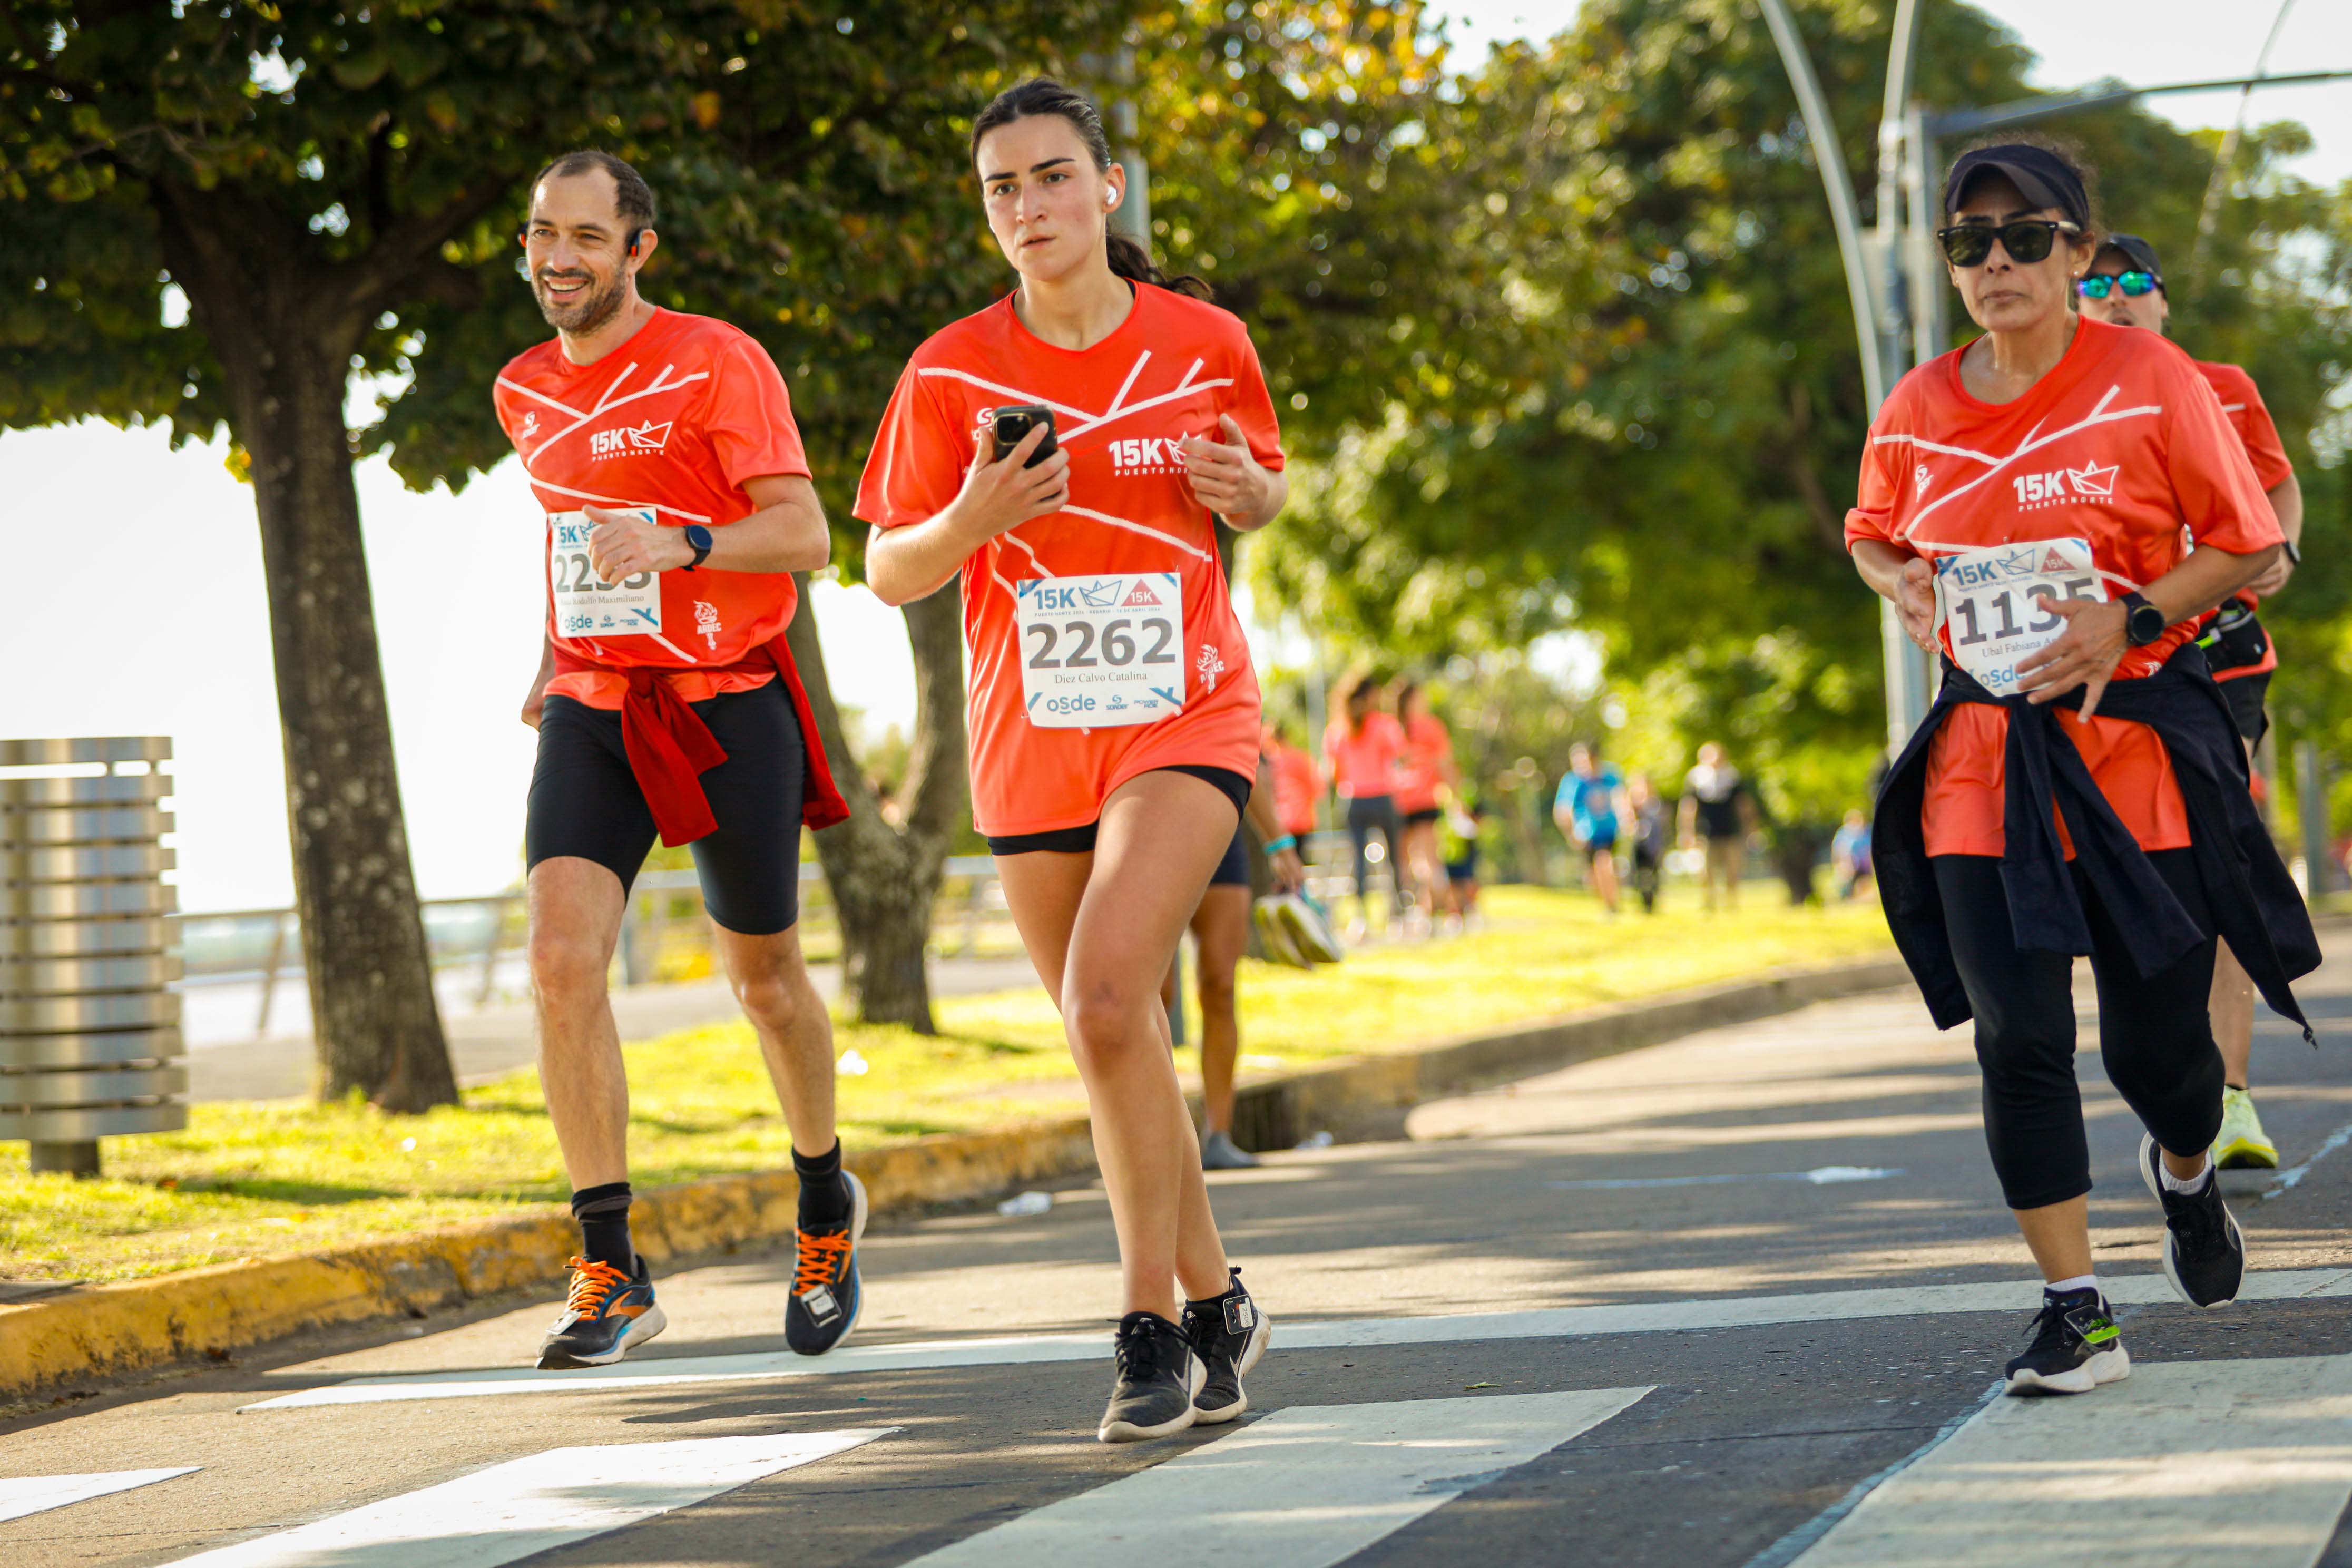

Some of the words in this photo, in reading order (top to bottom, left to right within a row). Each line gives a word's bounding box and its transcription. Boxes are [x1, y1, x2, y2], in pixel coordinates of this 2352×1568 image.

[590, 428, 626, 455] 15K
[592, 450, 627, 462] PUERTO
[1109, 438, 1164, 467] 15K
[1115, 467, 1164, 476] PUERTO
[2013, 470, 2065, 503] 15K
[2018, 498, 2066, 512] PUERTO
[560, 526, 578, 543] 5K
[2044, 558, 2067, 569] 15K
[1952, 561, 1997, 585] 15K
[573, 596, 596, 605] Rodolfo
[599, 595, 644, 603] Maximiliano
[1034, 587, 1076, 610] 15K
[1130, 591, 1153, 603] 15K
[565, 614, 593, 631] osde
[1027, 618, 1176, 669] 2262
[1982, 645, 2003, 658] Ubal
[2005, 640, 2041, 653] Fabiana
[1055, 674, 1075, 683] Diez
[1079, 672, 1105, 683] Calvo
[1109, 672, 1148, 681] Catalina
[1046, 693, 1096, 714] osde
